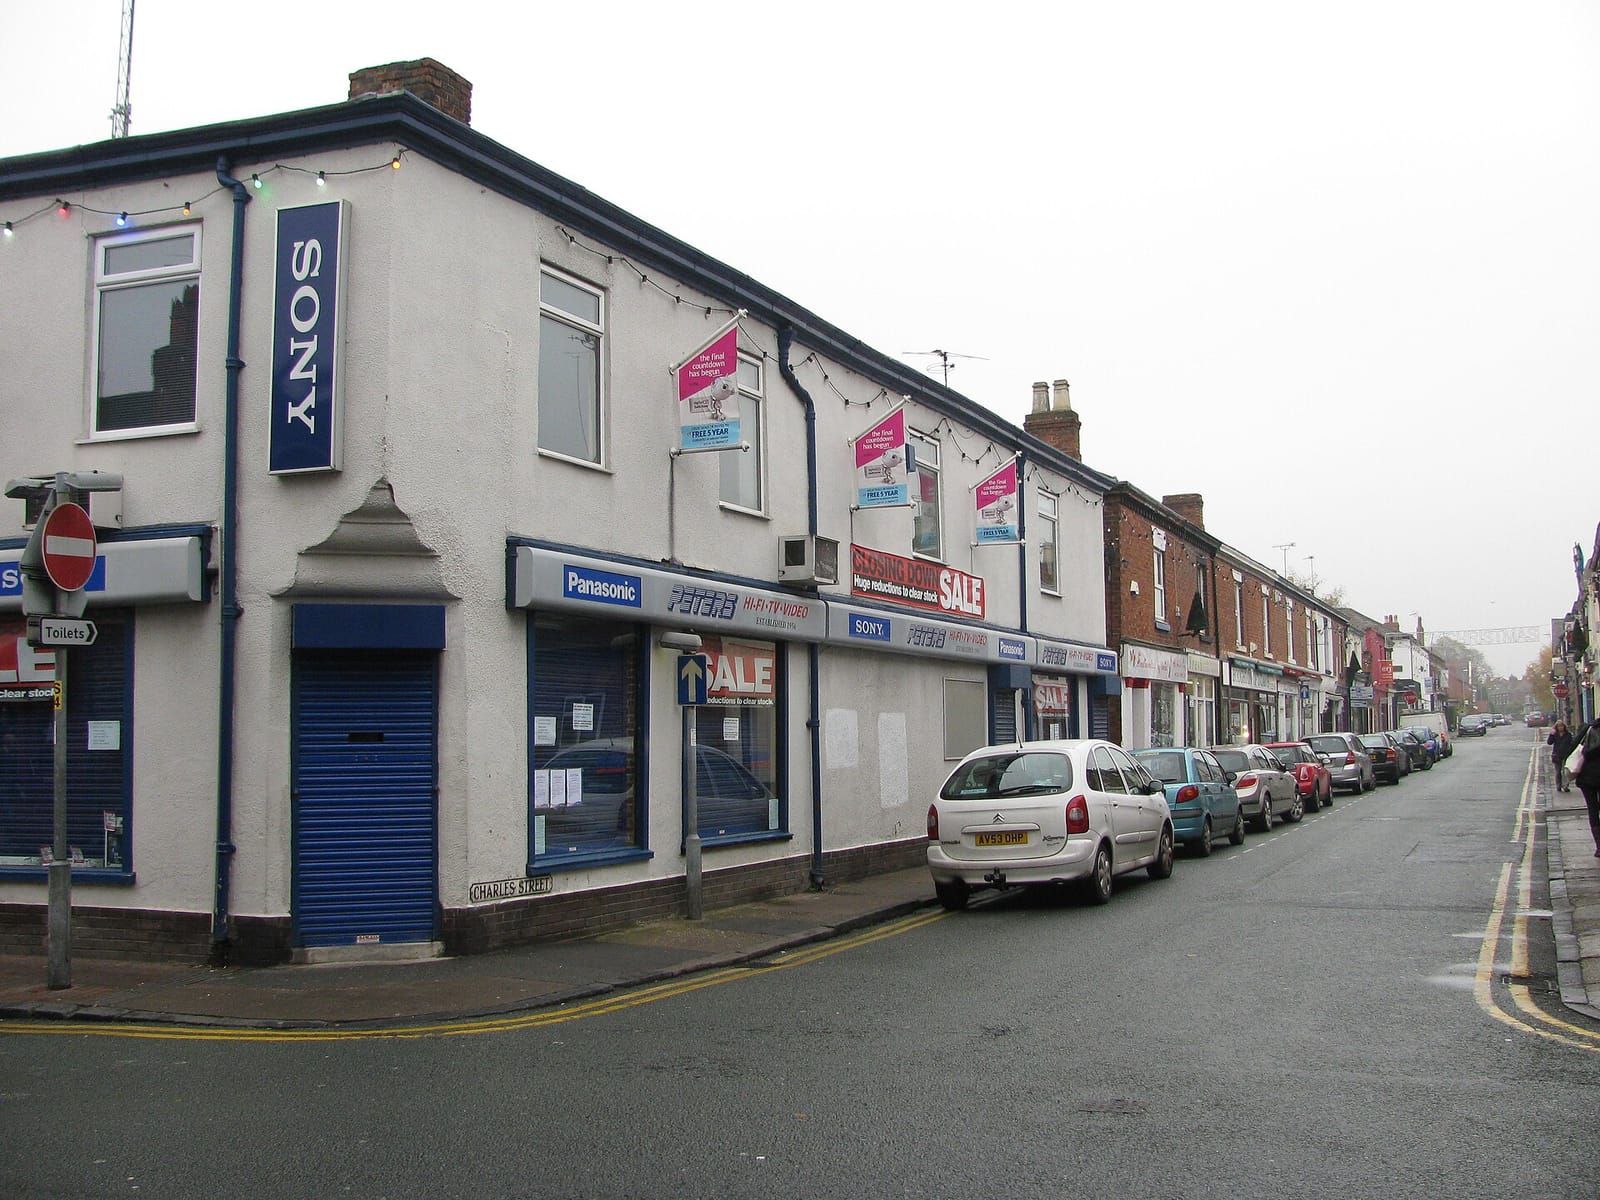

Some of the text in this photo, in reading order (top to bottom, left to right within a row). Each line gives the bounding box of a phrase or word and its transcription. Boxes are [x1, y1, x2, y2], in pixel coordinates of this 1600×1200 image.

[287, 238, 322, 435] SONY
[692, 360, 726, 370] countdown
[699, 352, 725, 362] the final
[688, 369, 700, 378] has
[691, 427, 729, 439] FREE 5 YEAR
[865, 436, 894, 444] countdown
[852, 548, 940, 588] CLOSING DOWN
[568, 571, 636, 601] Panasonic
[853, 574, 938, 603] Huge reductions to clear stock
[939, 569, 982, 616] SALE
[667, 583, 738, 620] PETERS
[45, 626, 85, 639] Toilets
[855, 619, 883, 636] SONY
[907, 623, 947, 649] PETERS
[1000, 641, 1024, 656] Panasonic
[1042, 646, 1068, 666] PETERS
[737, 697, 743, 705] to
[743, 697, 757, 705] clear
[1035, 684, 1067, 710] SALE
[978, 832, 1024, 845] AV53 OHP
[473, 877, 549, 900] CHARLES STREET
